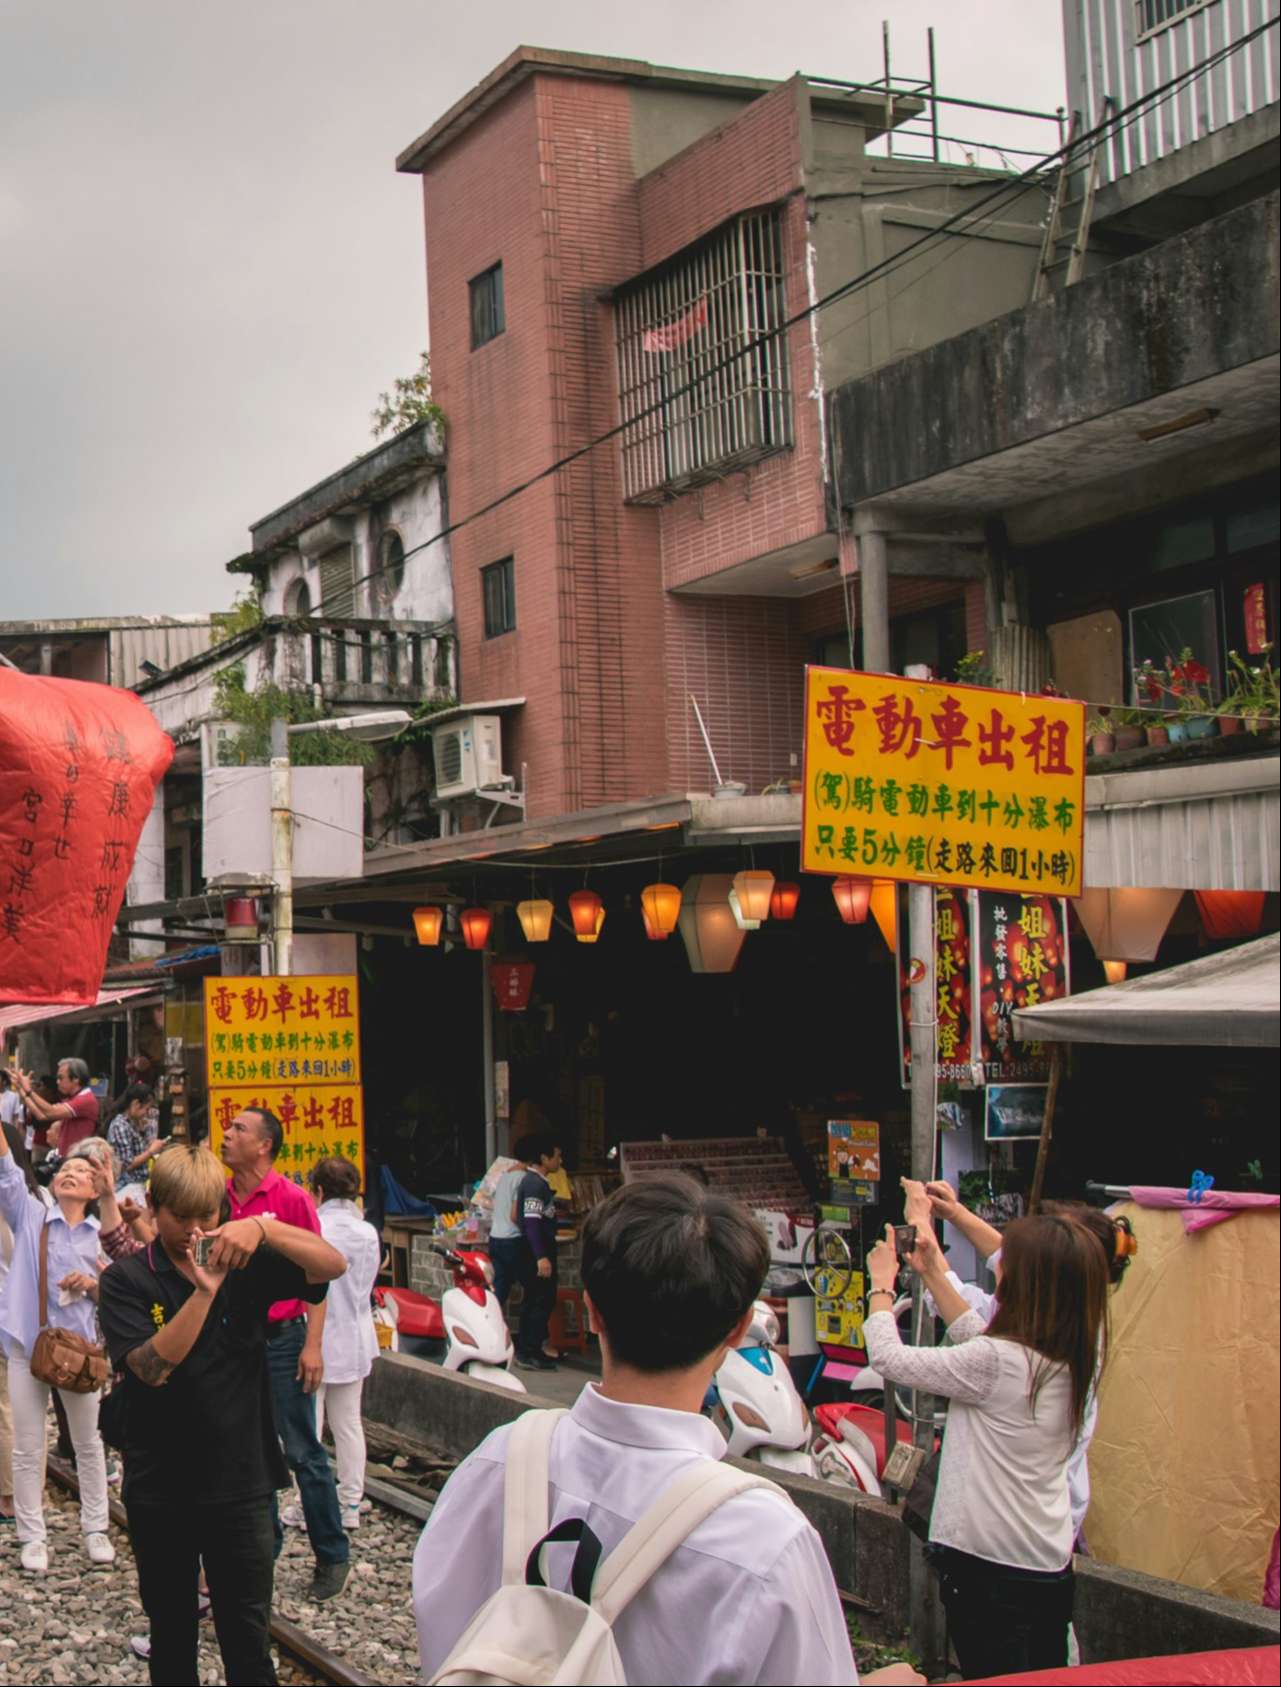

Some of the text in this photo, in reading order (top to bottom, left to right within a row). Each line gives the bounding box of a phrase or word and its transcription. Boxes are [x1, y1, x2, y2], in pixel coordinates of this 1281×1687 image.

[816, 685, 1074, 776] 電動車出租
[815, 769, 1075, 837] (駕)騎電動車到十分瀑布
[211, 983, 354, 1024] 電動車出租
[991, 1001, 1013, 1016] DIY
[215, 1093, 358, 1135] 電車出租
